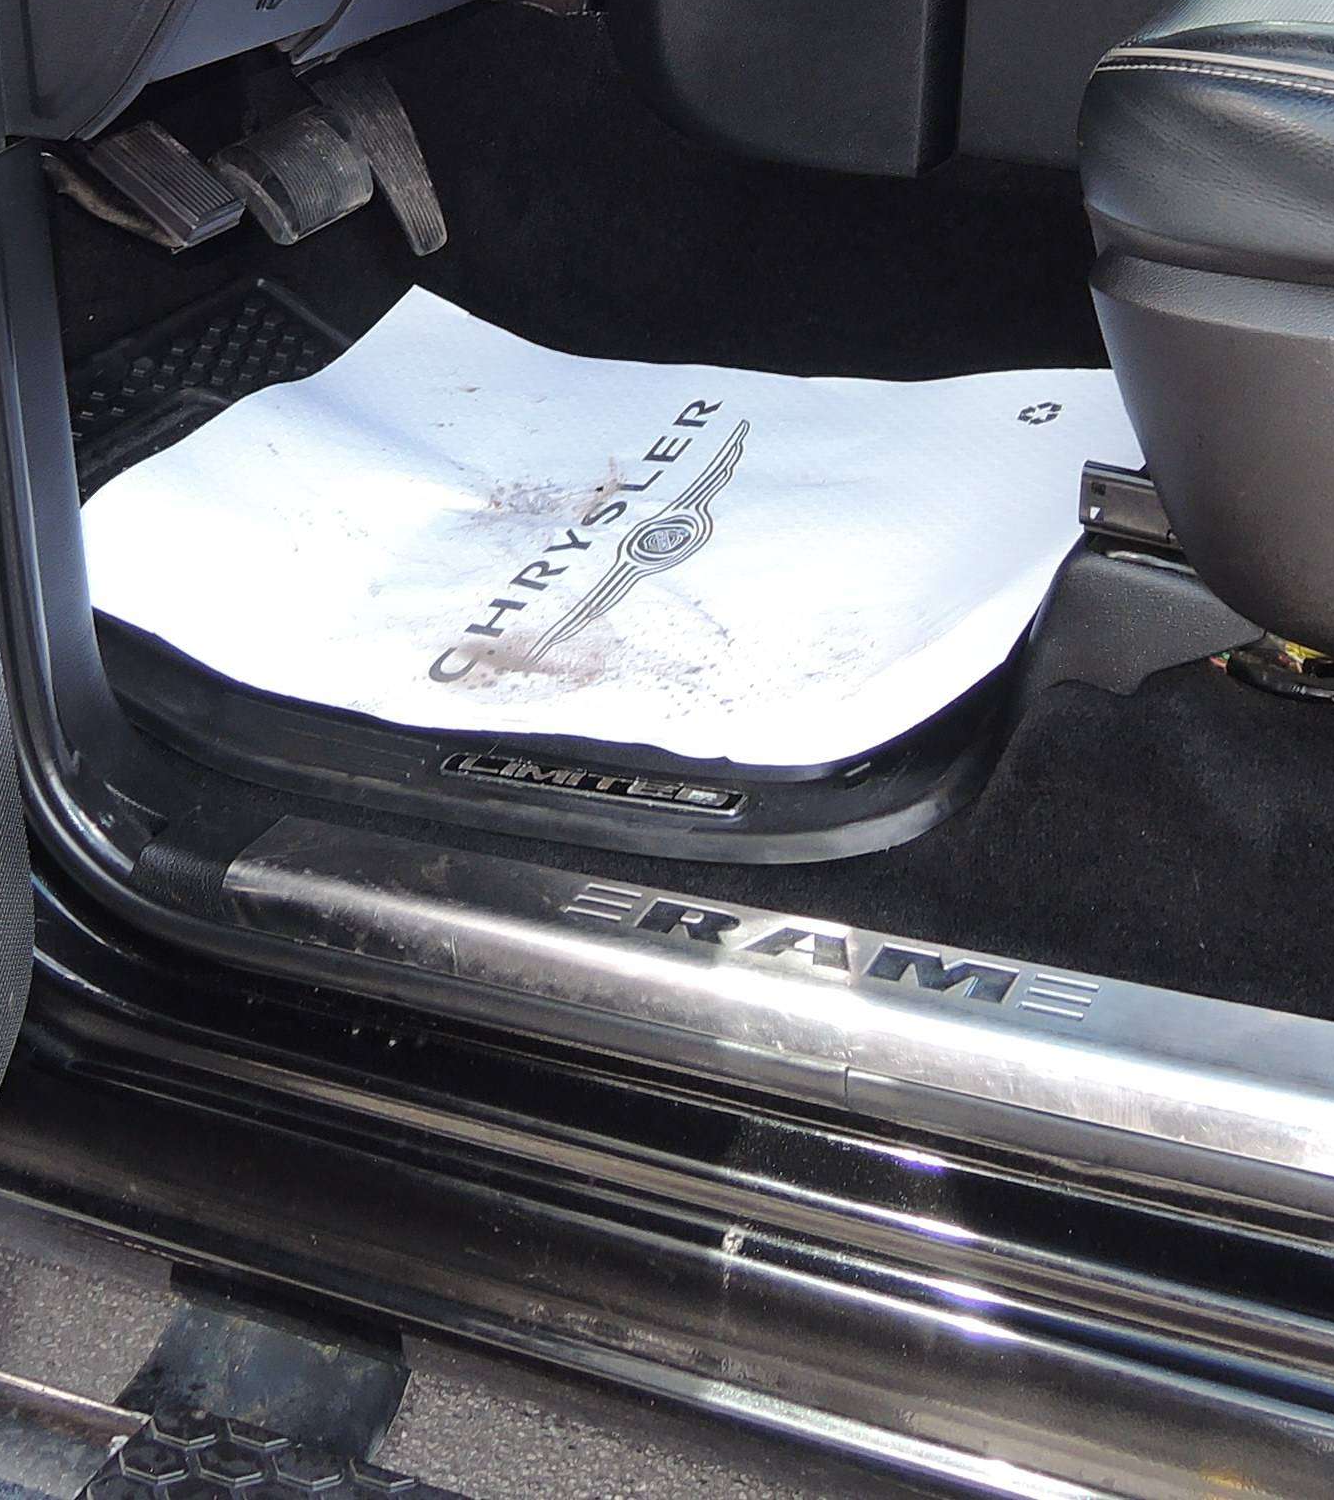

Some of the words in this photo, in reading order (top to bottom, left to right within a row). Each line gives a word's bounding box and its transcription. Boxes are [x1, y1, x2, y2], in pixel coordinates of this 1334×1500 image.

[429, 400, 724, 683] CHRYSLER
[458, 753, 731, 807] LIMITED
[635, 896, 1021, 1006] RAM
